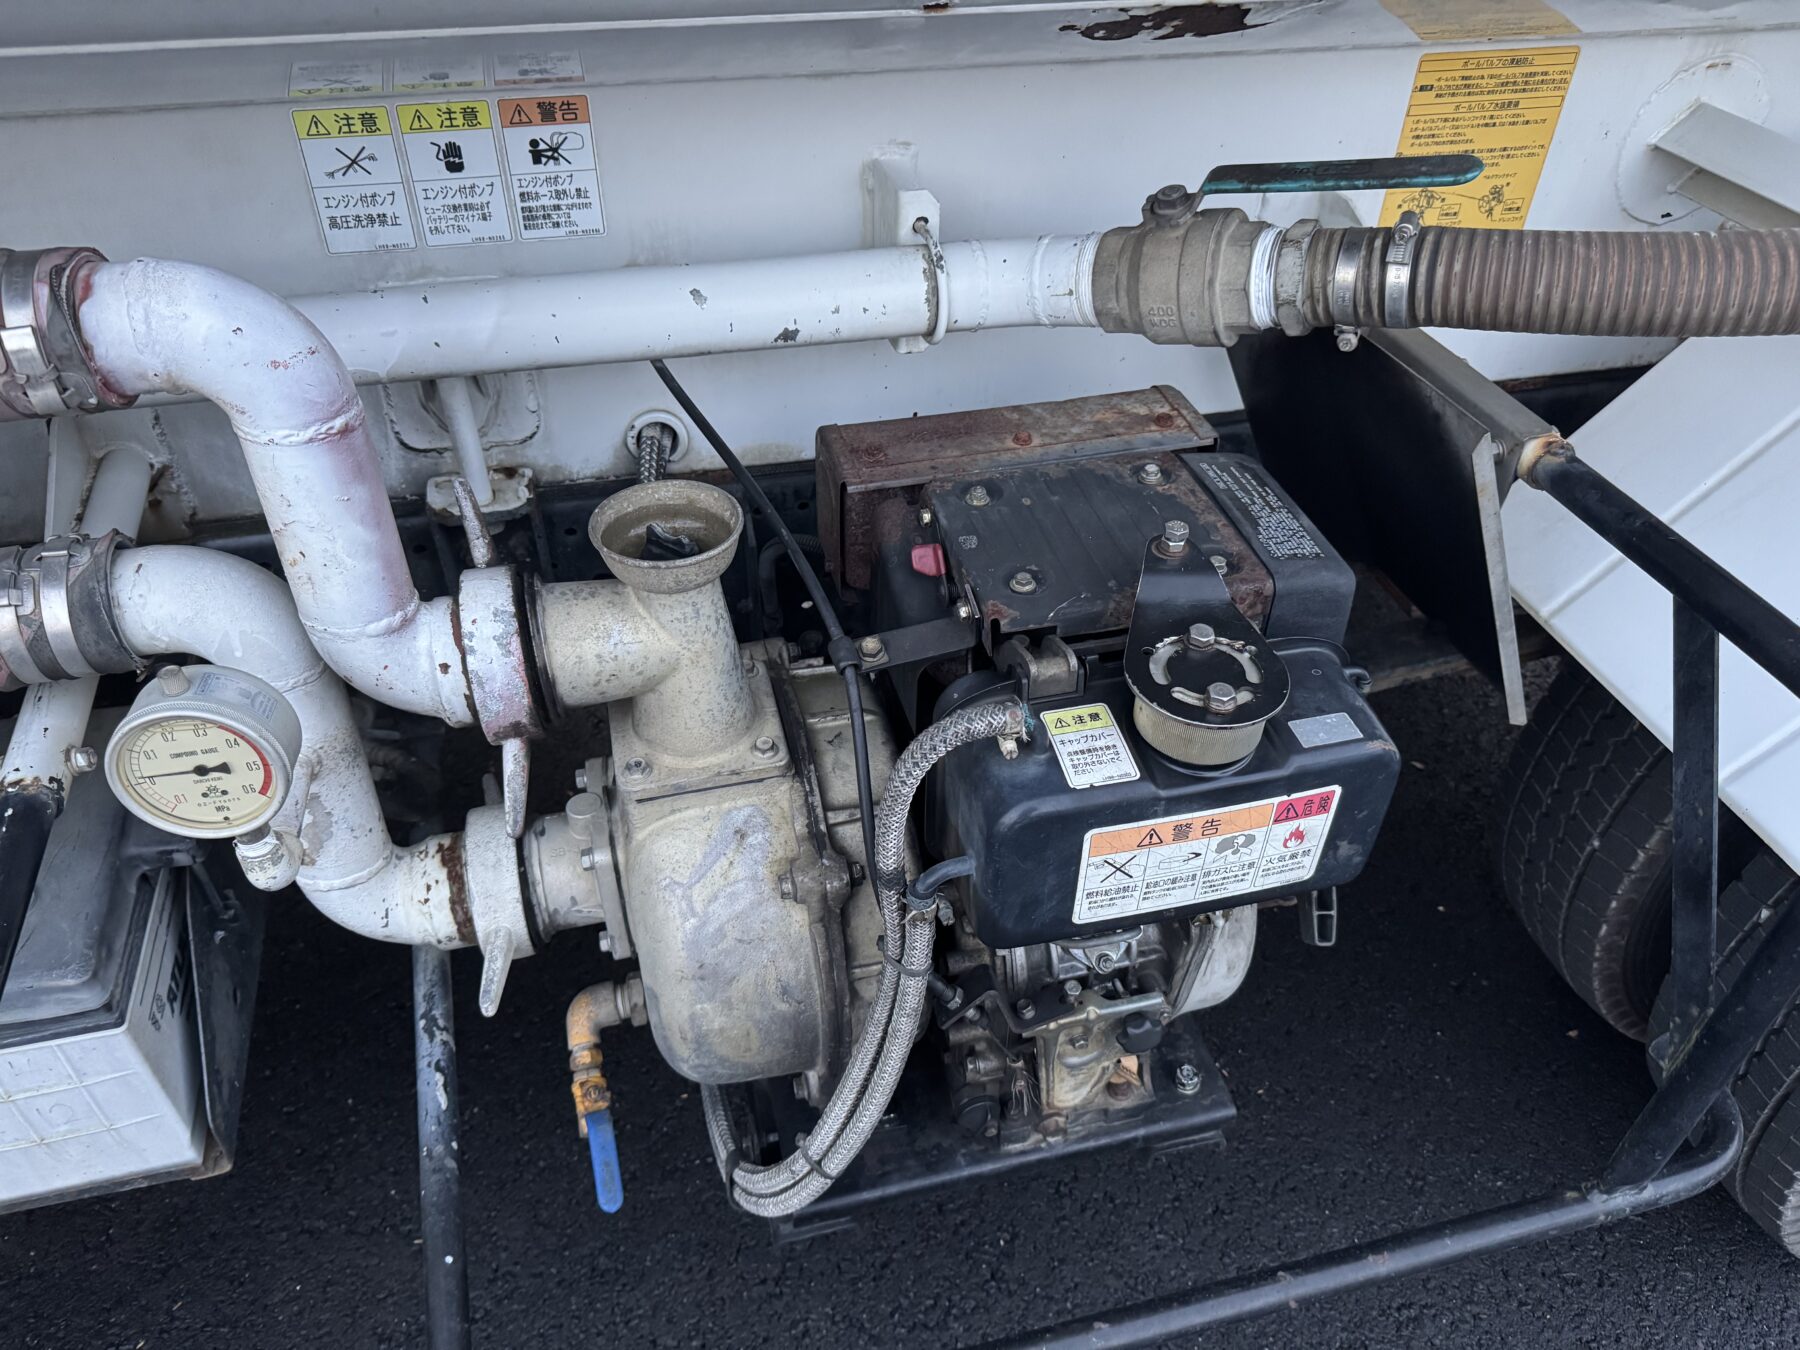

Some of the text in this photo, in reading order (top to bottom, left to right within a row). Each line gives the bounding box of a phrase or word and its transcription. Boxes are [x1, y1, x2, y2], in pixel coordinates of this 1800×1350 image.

[436, 105, 482, 129] 注意
[536, 100, 580, 123] 警告
[334, 111, 381, 135] 注意
[518, 186, 591, 203] 燃料ホース取外し禁止
[326, 211, 402, 231] 高圧洗浄禁止
[1072, 712, 1102, 725] 注意
[161, 731, 176, 742] 0.2
[193, 728, 208, 738] 0.3
[1059, 731, 1115, 748] キャップカバー
[225, 738, 240, 749] 0.4
[143, 749, 158, 760] 0.1
[169, 746, 220, 759] COMPOUND GAUGE
[245, 761, 260, 772] 0.5
[148, 776, 156, 786] 0
[241, 784, 256, 794] 0.6
[174, 793, 188, 804] 0.1
[1301, 794, 1331, 817] 危険
[214, 805, 231, 813] MPa
[1172, 818, 1222, 842] 警告
[1264, 849, 1312, 866] 火気厳禁
[1201, 861, 1257, 880] 排ガスに注意
[1085, 883, 1140, 900] 燃料給油禁止
